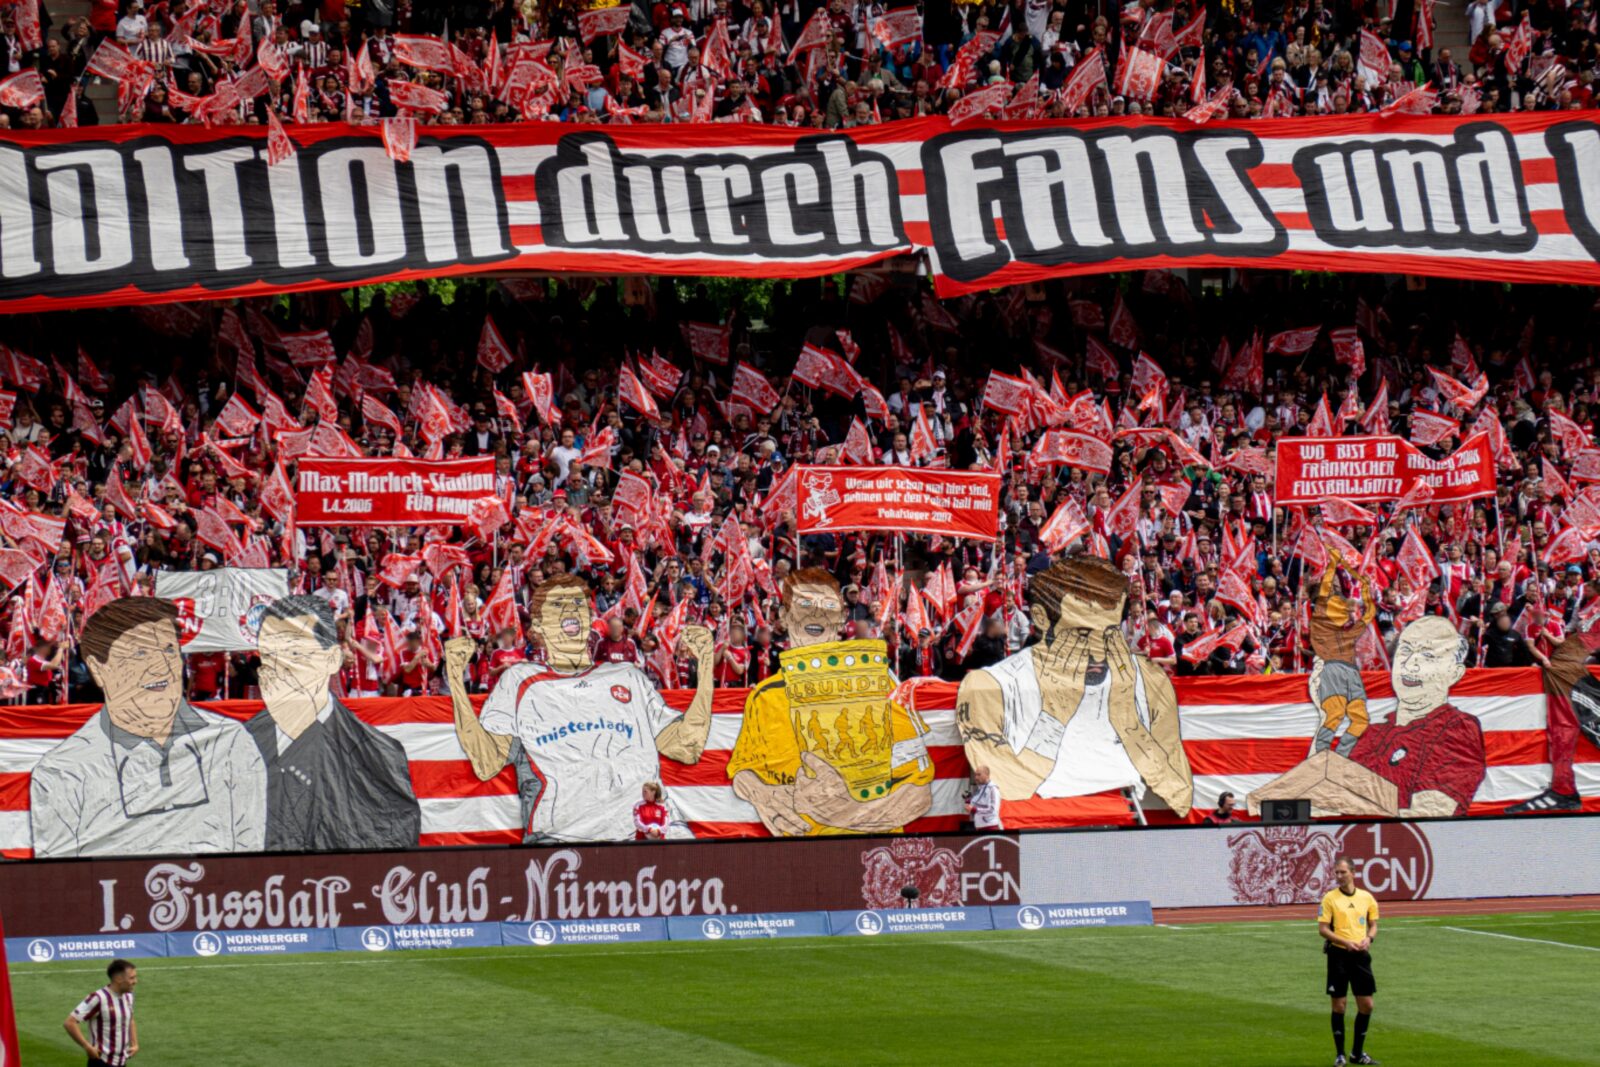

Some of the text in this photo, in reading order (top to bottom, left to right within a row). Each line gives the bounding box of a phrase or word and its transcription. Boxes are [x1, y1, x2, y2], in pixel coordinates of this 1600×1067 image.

[555, 140, 900, 246] durch
[1313, 130, 1527, 237] und
[1300, 442, 1399, 460] WO BIST DU,
[1301, 459, 1395, 478] FRÄNKISCHER
[299, 470, 494, 494] Max-Morlock-Stadion
[845, 477, 874, 490] Wenn
[876, 477, 894, 489] wir
[896, 479, 923, 492] schon
[926, 482, 944, 494] mal
[946, 482, 966, 495] hier
[1292, 478, 1403, 496] FUSSBALLGOTT?
[405, 491, 475, 516] FÜR IMME
[843, 490, 882, 503] nehmen
[884, 490, 902, 502] wir
[904, 491, 922, 503] den
[923, 493, 951, 508] Pokal
[953, 496, 972, 509] halt
[878, 507, 930, 521] Pokalsieger
[194, 571, 251, 618] 3:0
[1366, 823, 1390, 855] 1.
[983, 841, 1003, 869] 1.
[886, 911, 966, 924] NÜRNBERGER
[1048, 906, 1127, 920] NÜRNBERGER
[560, 923, 641, 935] NÜRNBERGER
[728, 918, 796, 930] NÜRNBERGER
[888, 922, 944, 932] VERSICHERUNG
[1050, 917, 1107, 927] VERSICHERUNG
[226, 933, 309, 945] NÜRNBERGER
[393, 926, 475, 940] NÜRNBERGER
[561, 933, 620, 943] VERSICHERUNG
[58, 939, 136, 951] NÜRNBERGER
[227, 943, 286, 953] VERSICHERUNG
[395, 937, 452, 948] VERSICHERUNG
[59, 949, 115, 959] VERSICHERUNG
